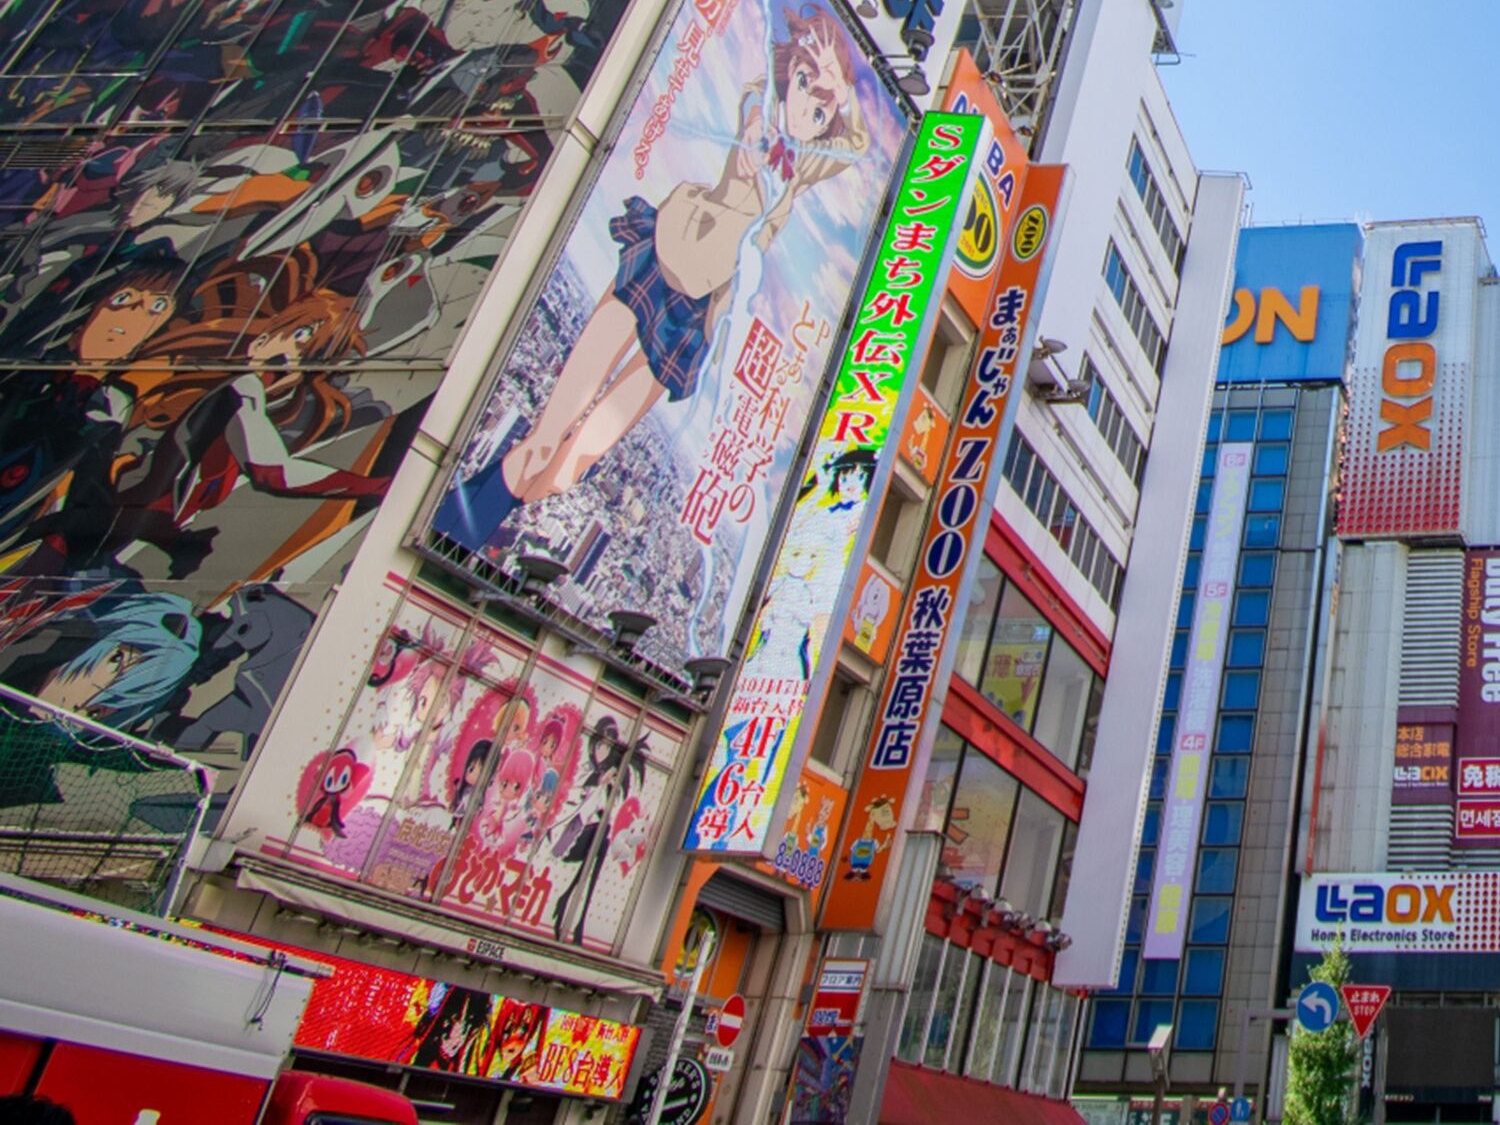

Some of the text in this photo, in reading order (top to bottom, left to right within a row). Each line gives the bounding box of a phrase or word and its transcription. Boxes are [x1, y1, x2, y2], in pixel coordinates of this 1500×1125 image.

[679, 315, 785, 547] 超電磁砲
[869, 288, 1025, 772] まぁじゃん ZOO 秋葉原店
[1204, 582, 1227, 598] 5F
[1466, 557, 1484, 668] Flagship Store
[732, 715, 786, 760] 4F
[1180, 734, 1206, 750] 4F
[714, 761, 766, 808] 6台
[698, 807, 756, 841] 導入
[1311, 928, 1457, 943] Home Electronics Store
[475, 940, 507, 961] ESPACE
[1350, 991, 1380, 1004] 止まれ
[1354, 1005, 1376, 1017] STOP
